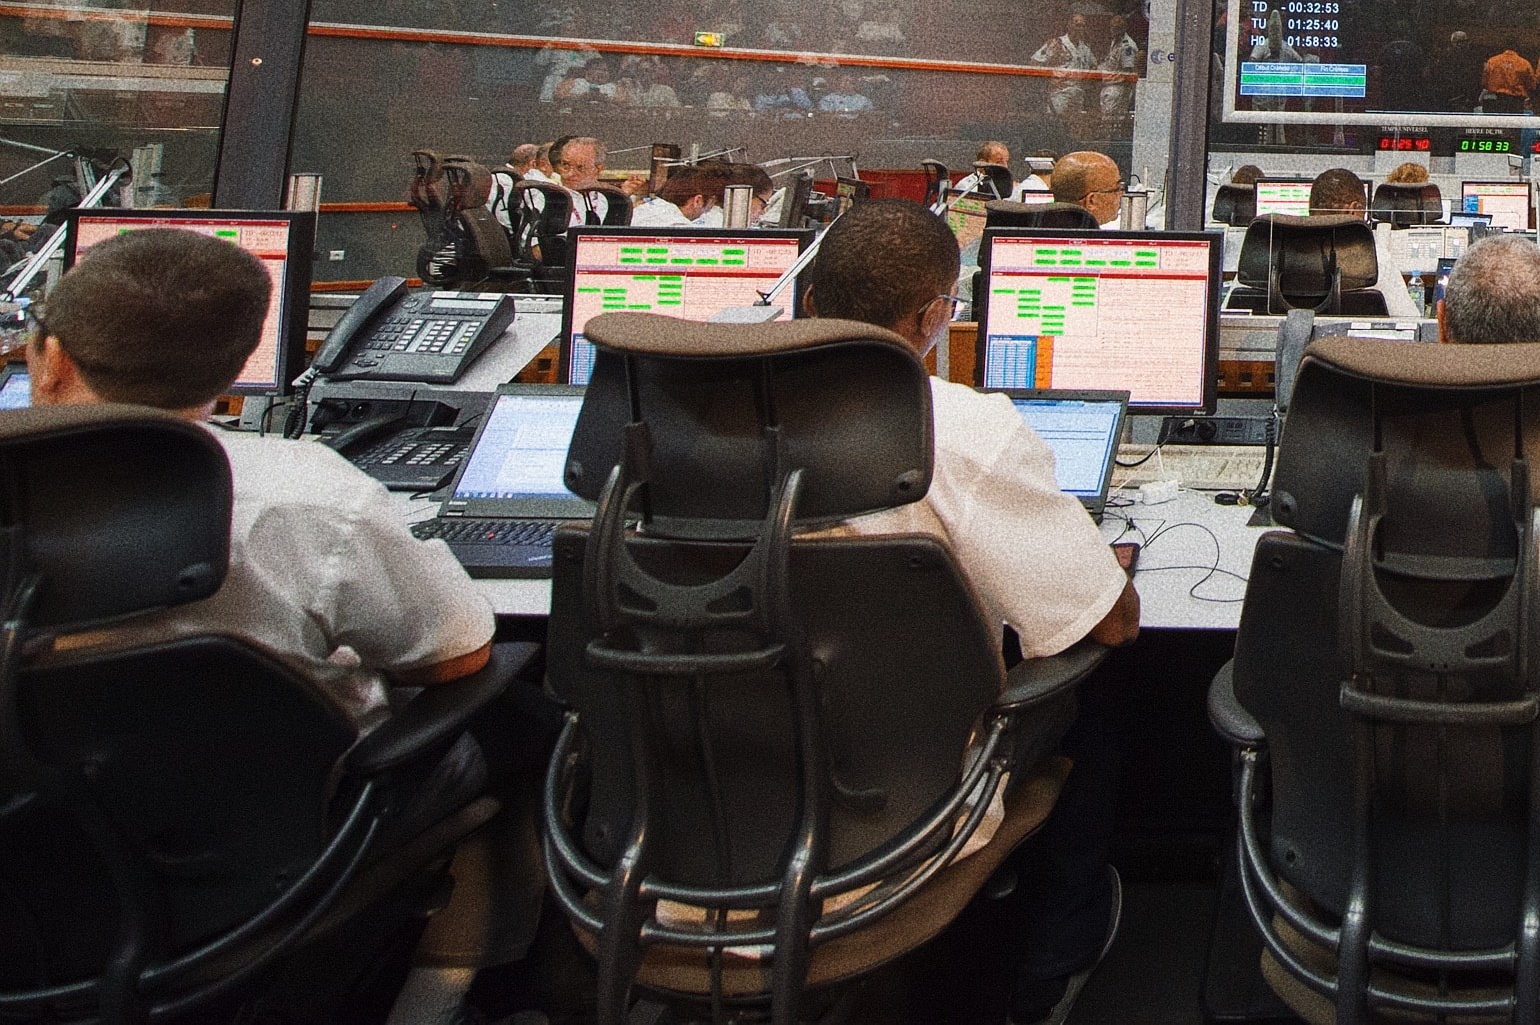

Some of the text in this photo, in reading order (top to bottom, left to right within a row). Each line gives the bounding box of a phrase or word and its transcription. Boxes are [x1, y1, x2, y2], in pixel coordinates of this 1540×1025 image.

[1252, 1, 1268, 12] TD
[1251, 18, 1338, 30] TU 01:25:40
[1287, 36, 1338, 47] 01:58:33
